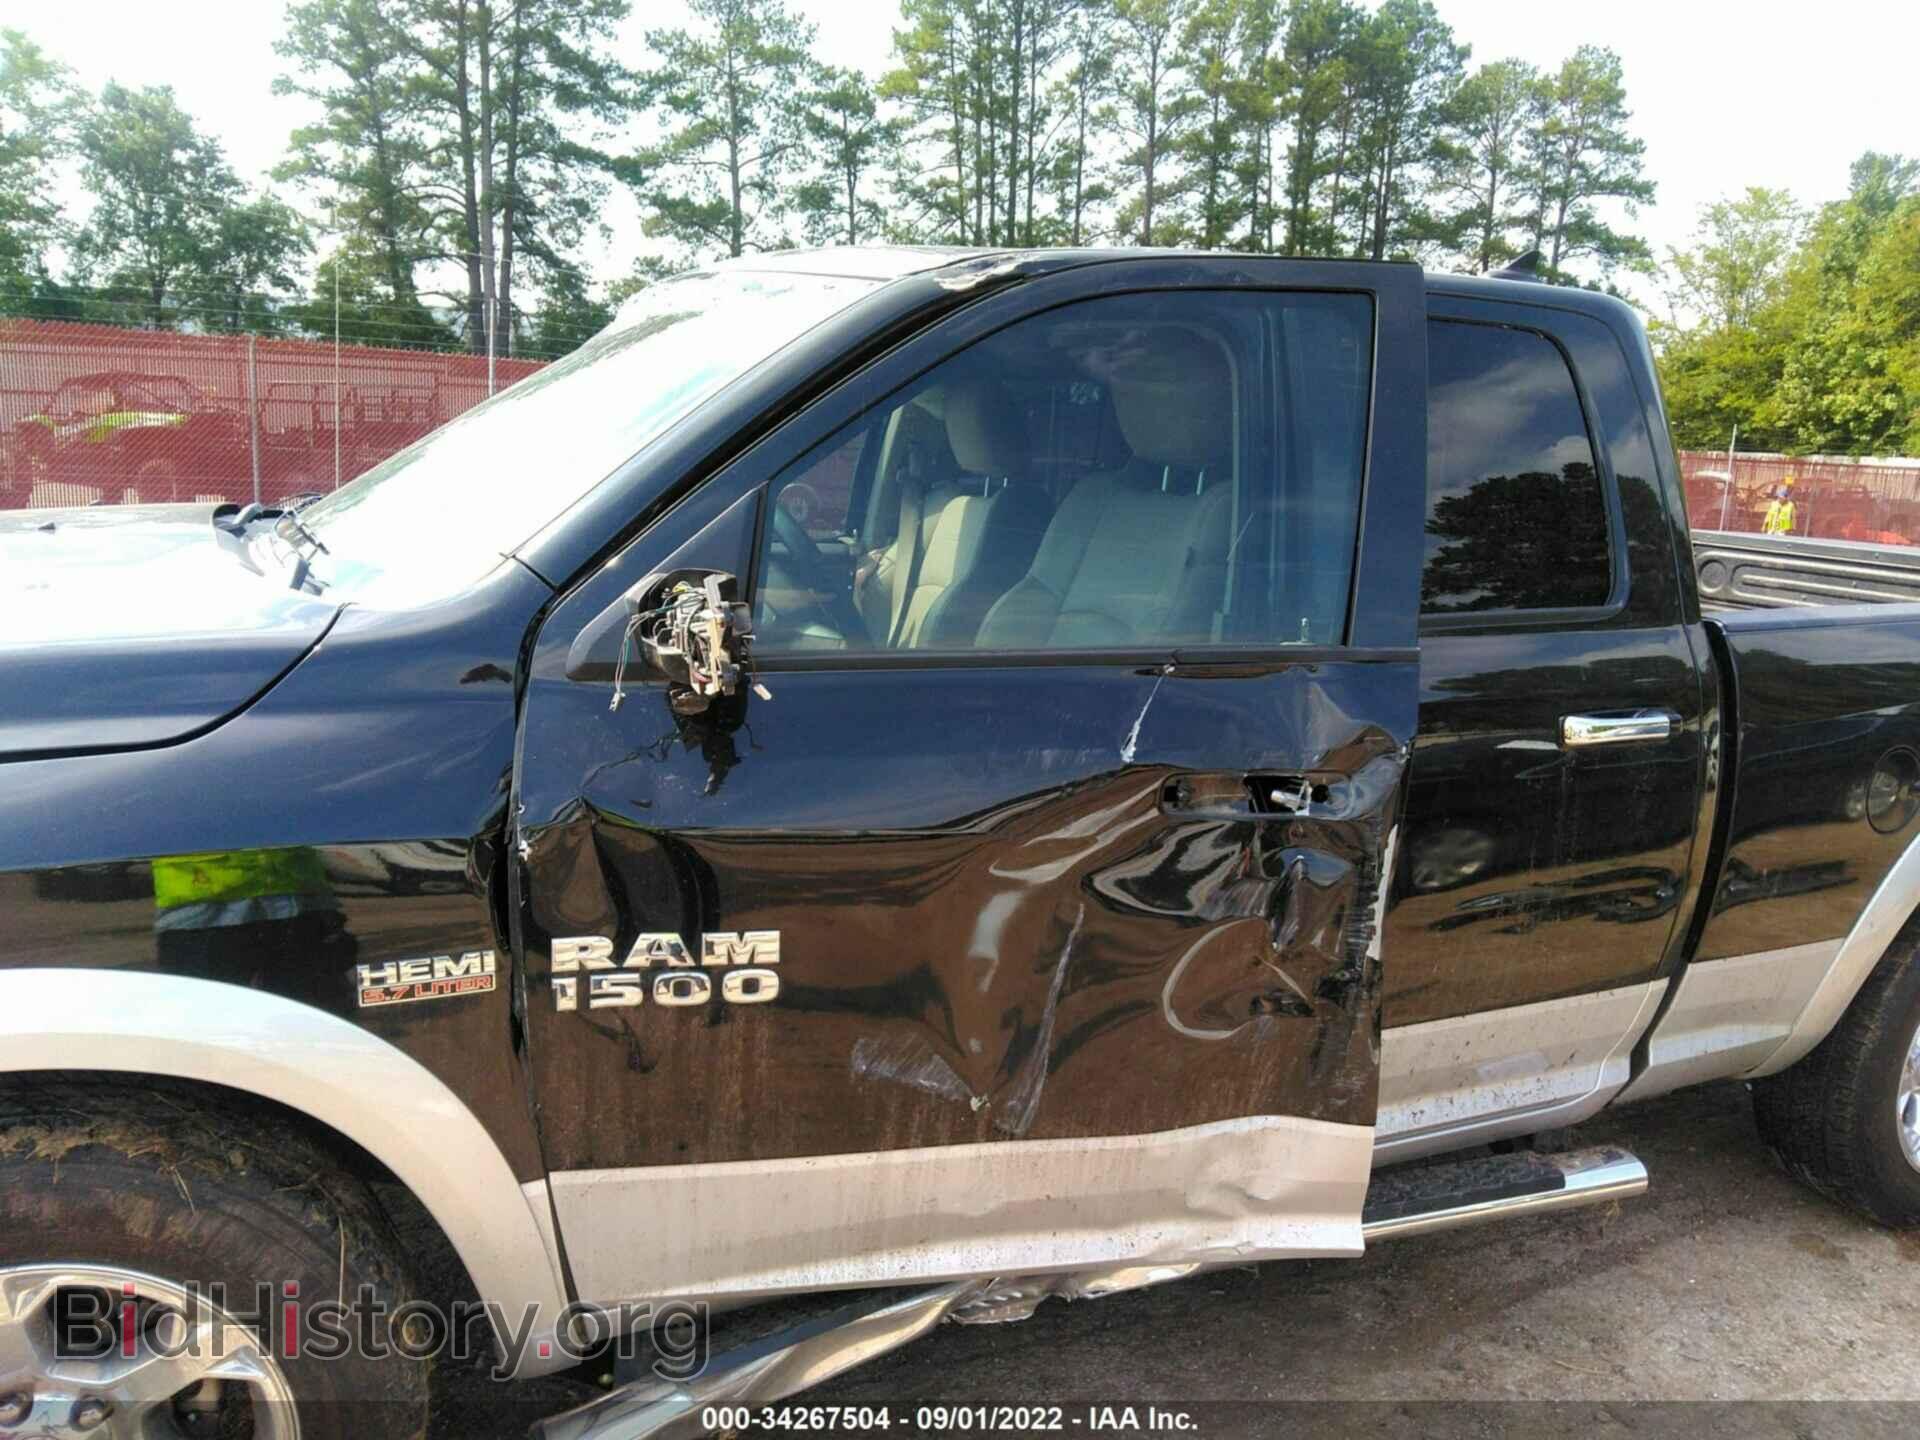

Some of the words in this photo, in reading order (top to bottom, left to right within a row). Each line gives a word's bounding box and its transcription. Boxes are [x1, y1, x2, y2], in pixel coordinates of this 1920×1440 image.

[356, 950, 495, 987] HEMI
[551, 930, 781, 970] RAM
[362, 986, 410, 1003] 5.7
[414, 975, 493, 998] LITER
[551, 967, 780, 1012] 1500
